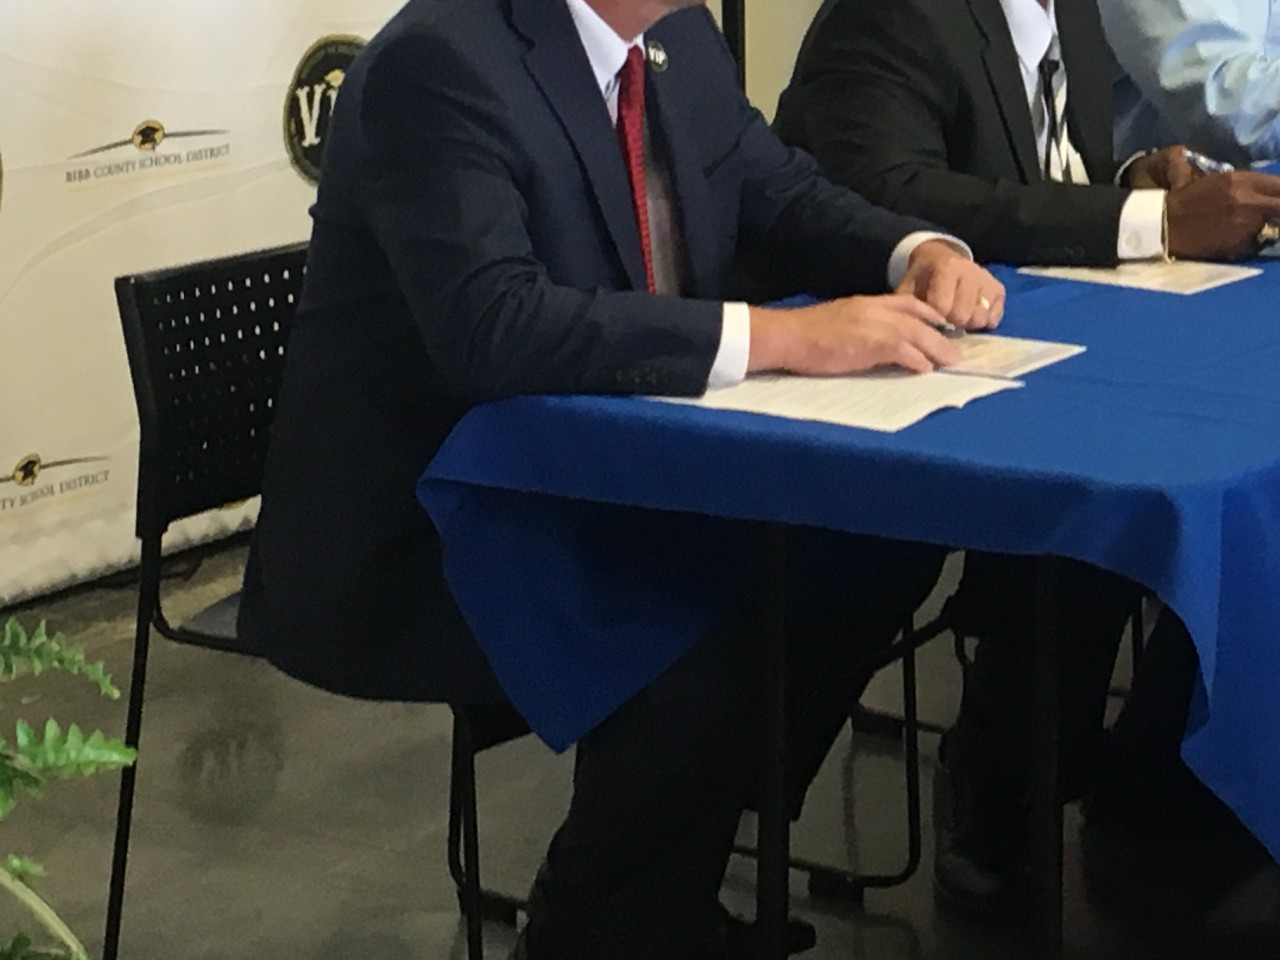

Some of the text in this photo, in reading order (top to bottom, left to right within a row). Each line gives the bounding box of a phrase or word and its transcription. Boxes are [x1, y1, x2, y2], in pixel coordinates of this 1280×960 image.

[66, 143, 231, 183] BIBB COUNTY SCHOOL DISTRICT
[59, 470, 110, 494] DISTRICT
